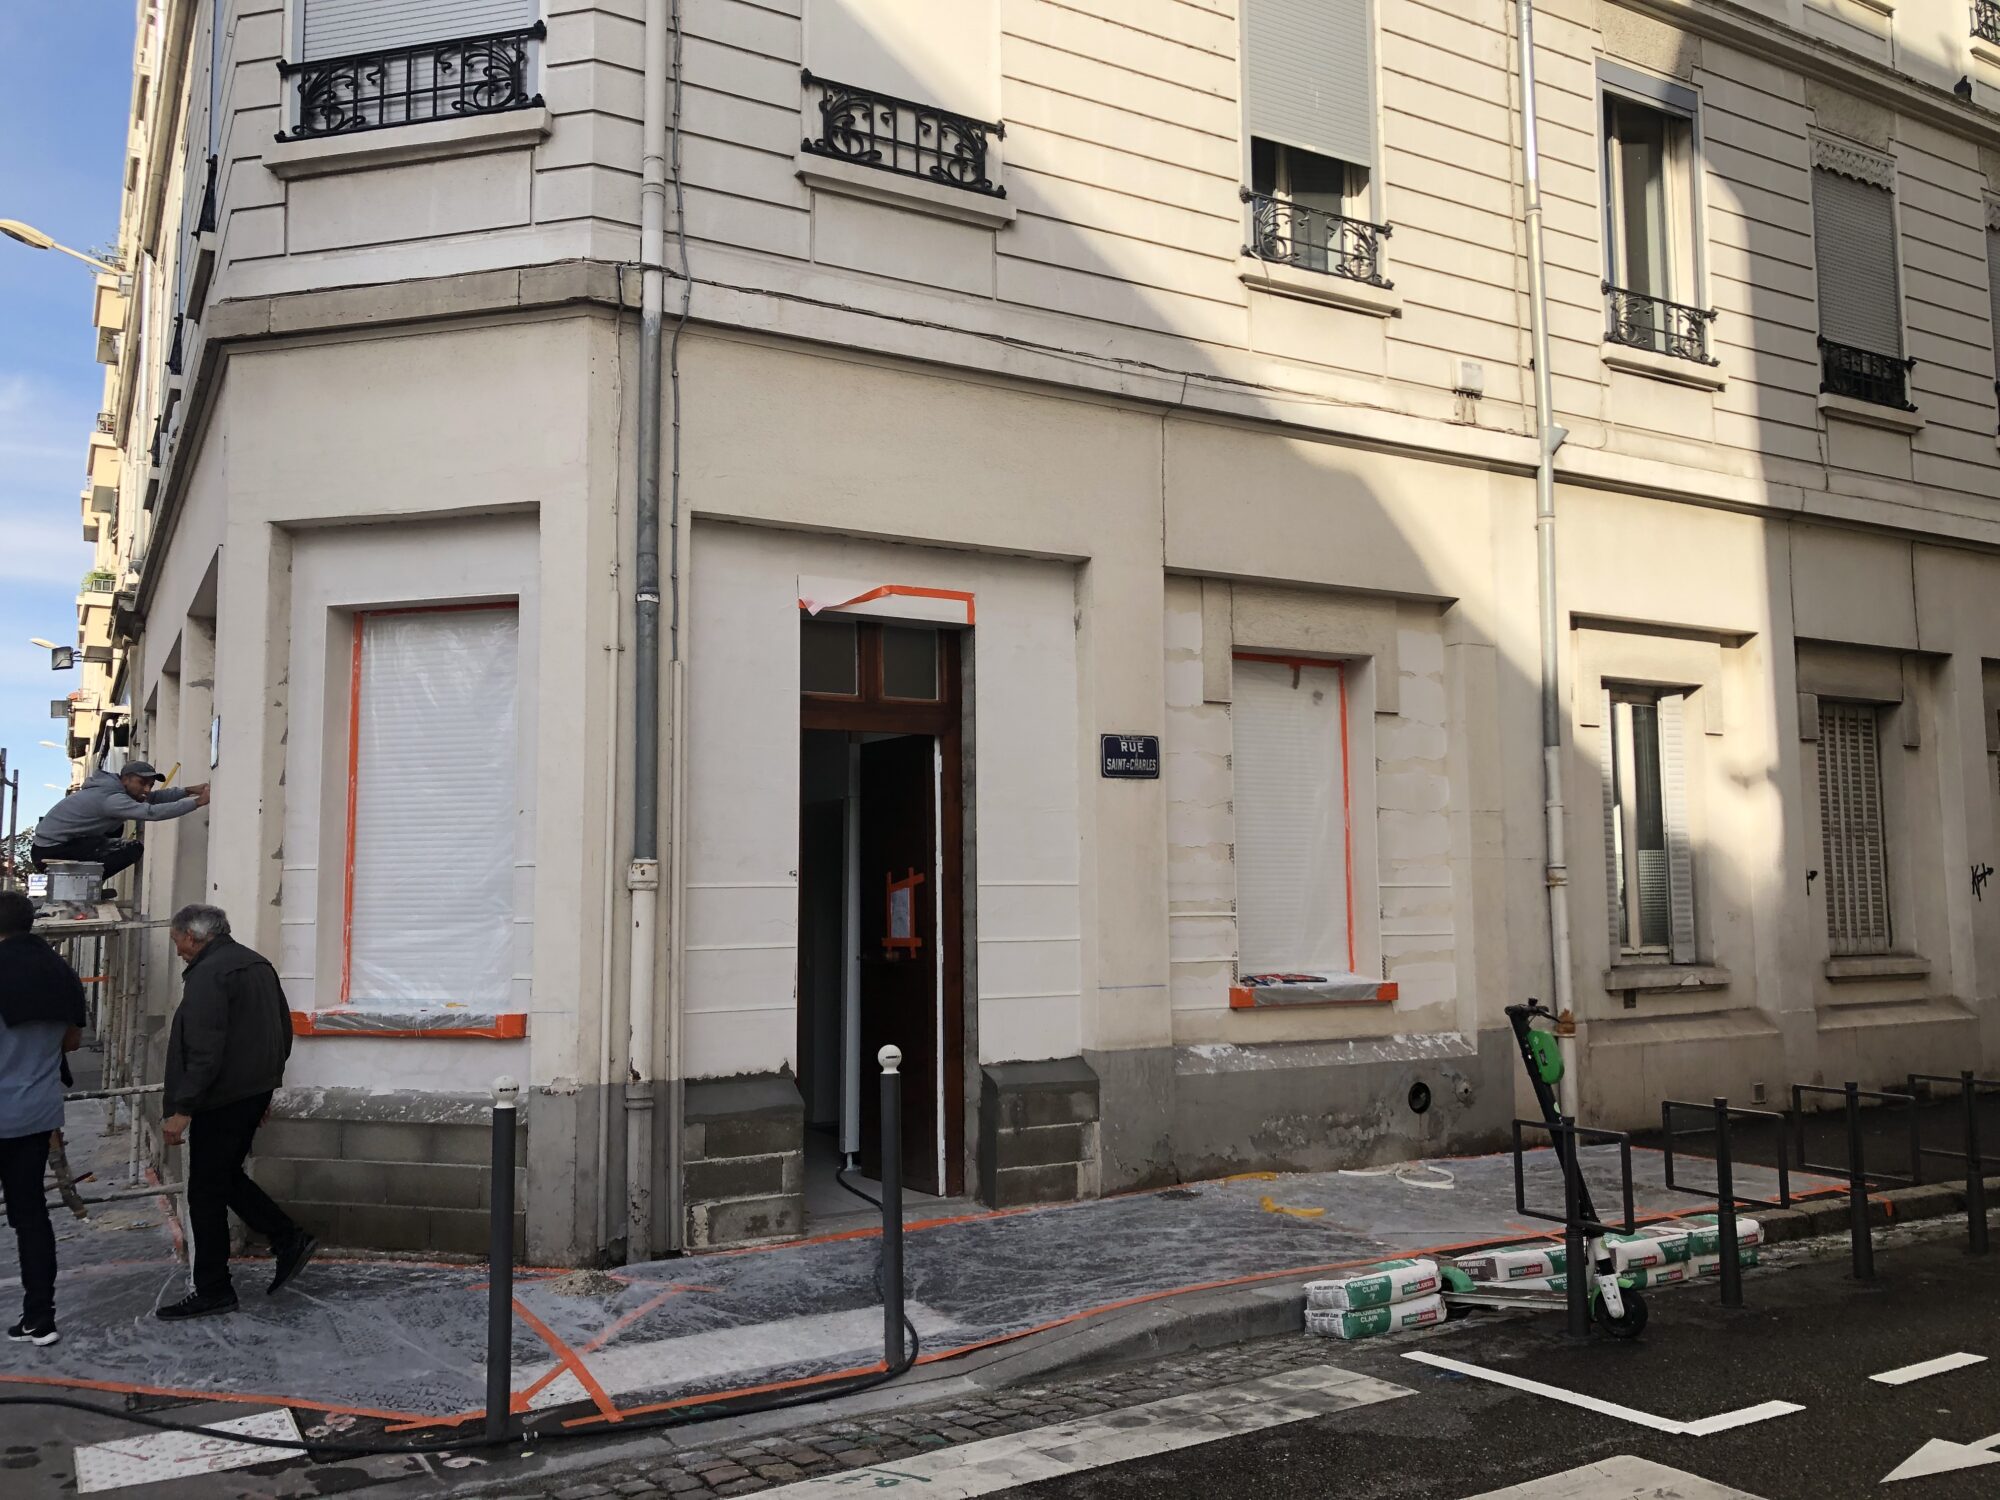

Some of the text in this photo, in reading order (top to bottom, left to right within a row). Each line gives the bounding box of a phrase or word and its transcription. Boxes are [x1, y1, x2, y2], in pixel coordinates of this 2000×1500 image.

[1120, 741, 1144, 753] RUE
[1362, 1285, 1380, 1293] CLAIR
[1360, 1315, 1379, 1323] CLAIR
